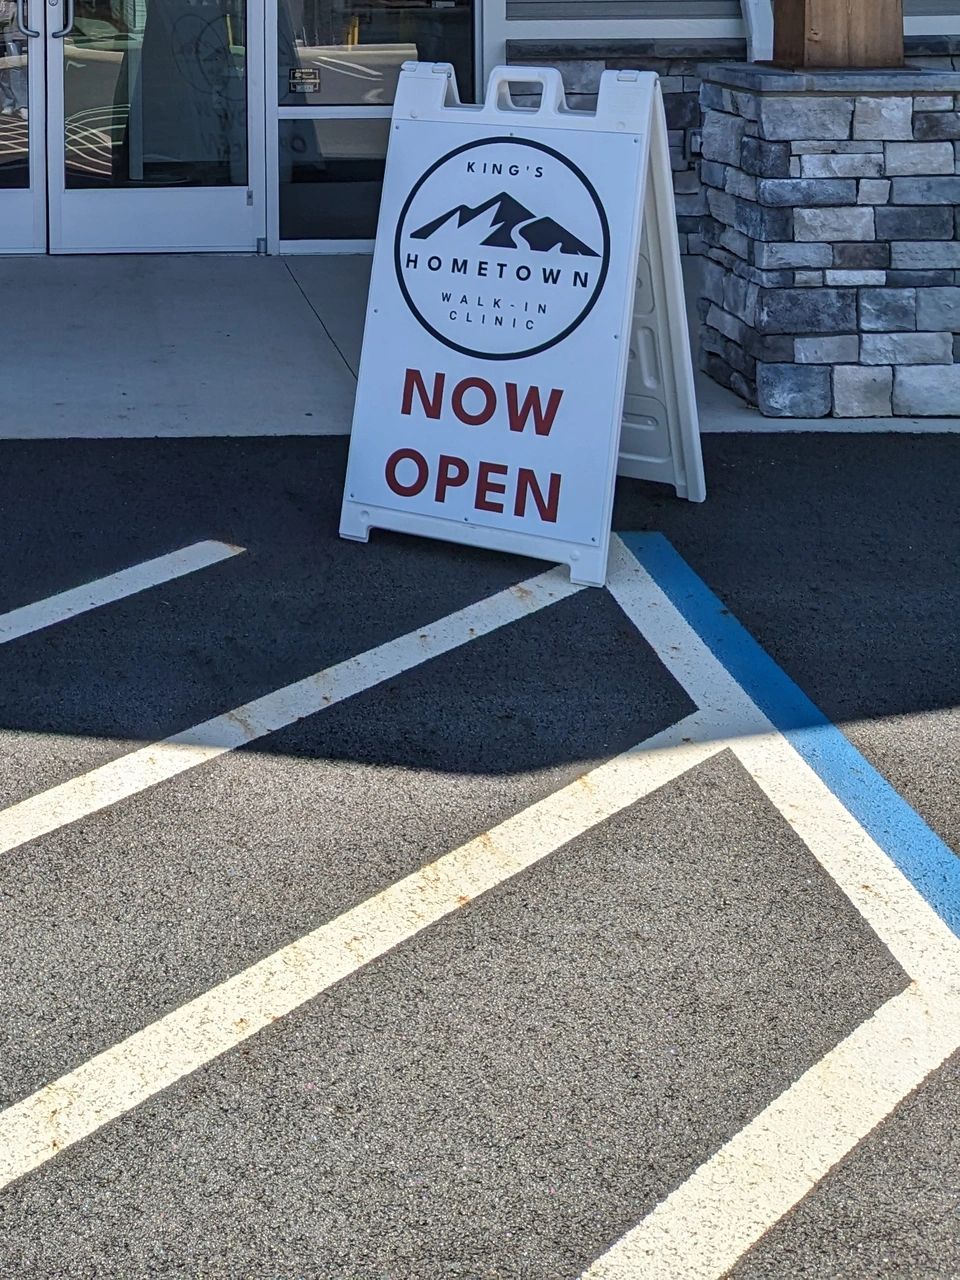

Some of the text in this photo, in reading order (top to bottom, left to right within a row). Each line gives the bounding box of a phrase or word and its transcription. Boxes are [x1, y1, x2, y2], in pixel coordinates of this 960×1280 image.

[466, 161, 544, 178] KING'S
[405, 253, 589, 288] HOMETOWN
[441, 292, 547, 314] WALK-IN
[449, 310, 534, 330] CLINIC
[400, 368, 565, 437] NOW
[384, 447, 563, 523] OPEN
